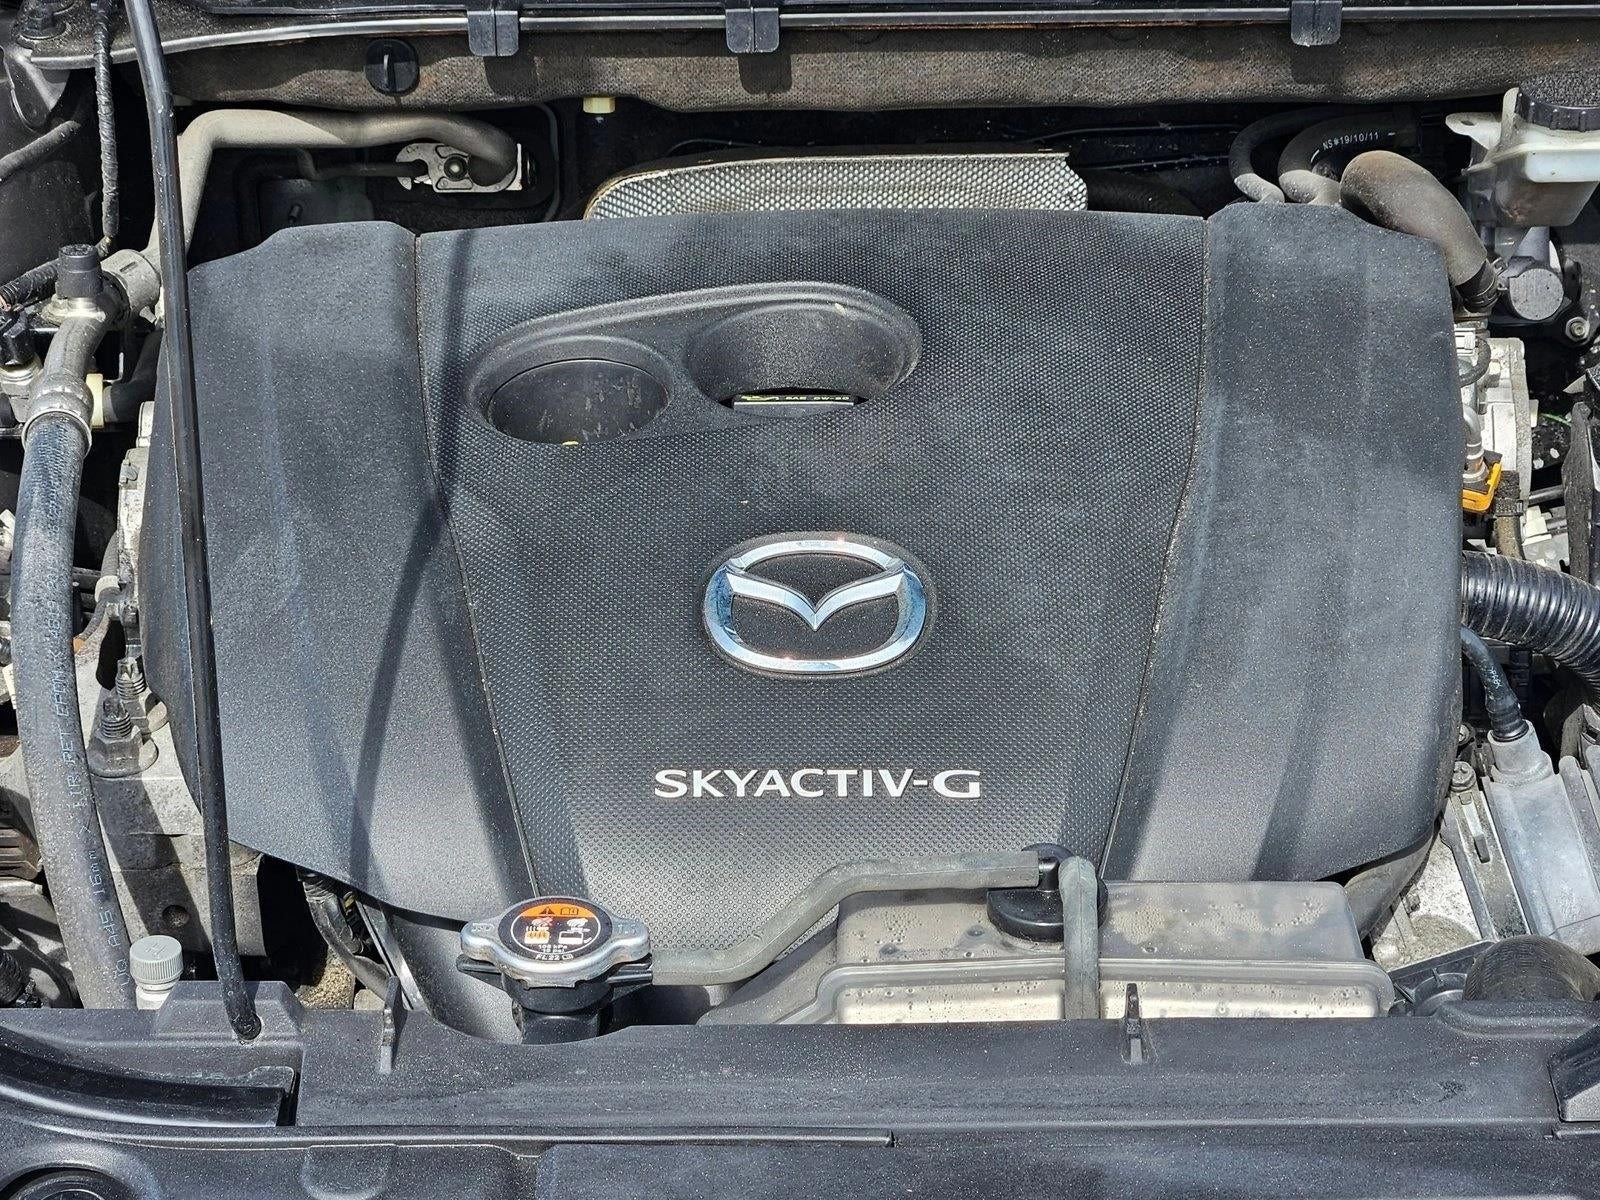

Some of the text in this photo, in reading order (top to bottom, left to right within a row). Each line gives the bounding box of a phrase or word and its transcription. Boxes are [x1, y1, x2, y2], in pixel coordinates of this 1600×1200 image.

[50, 670, 70, 717] EPDM
[58, 726, 76, 763] PET
[653, 767, 982, 800] SKYACTIV-G
[99, 909, 122, 948] A45
